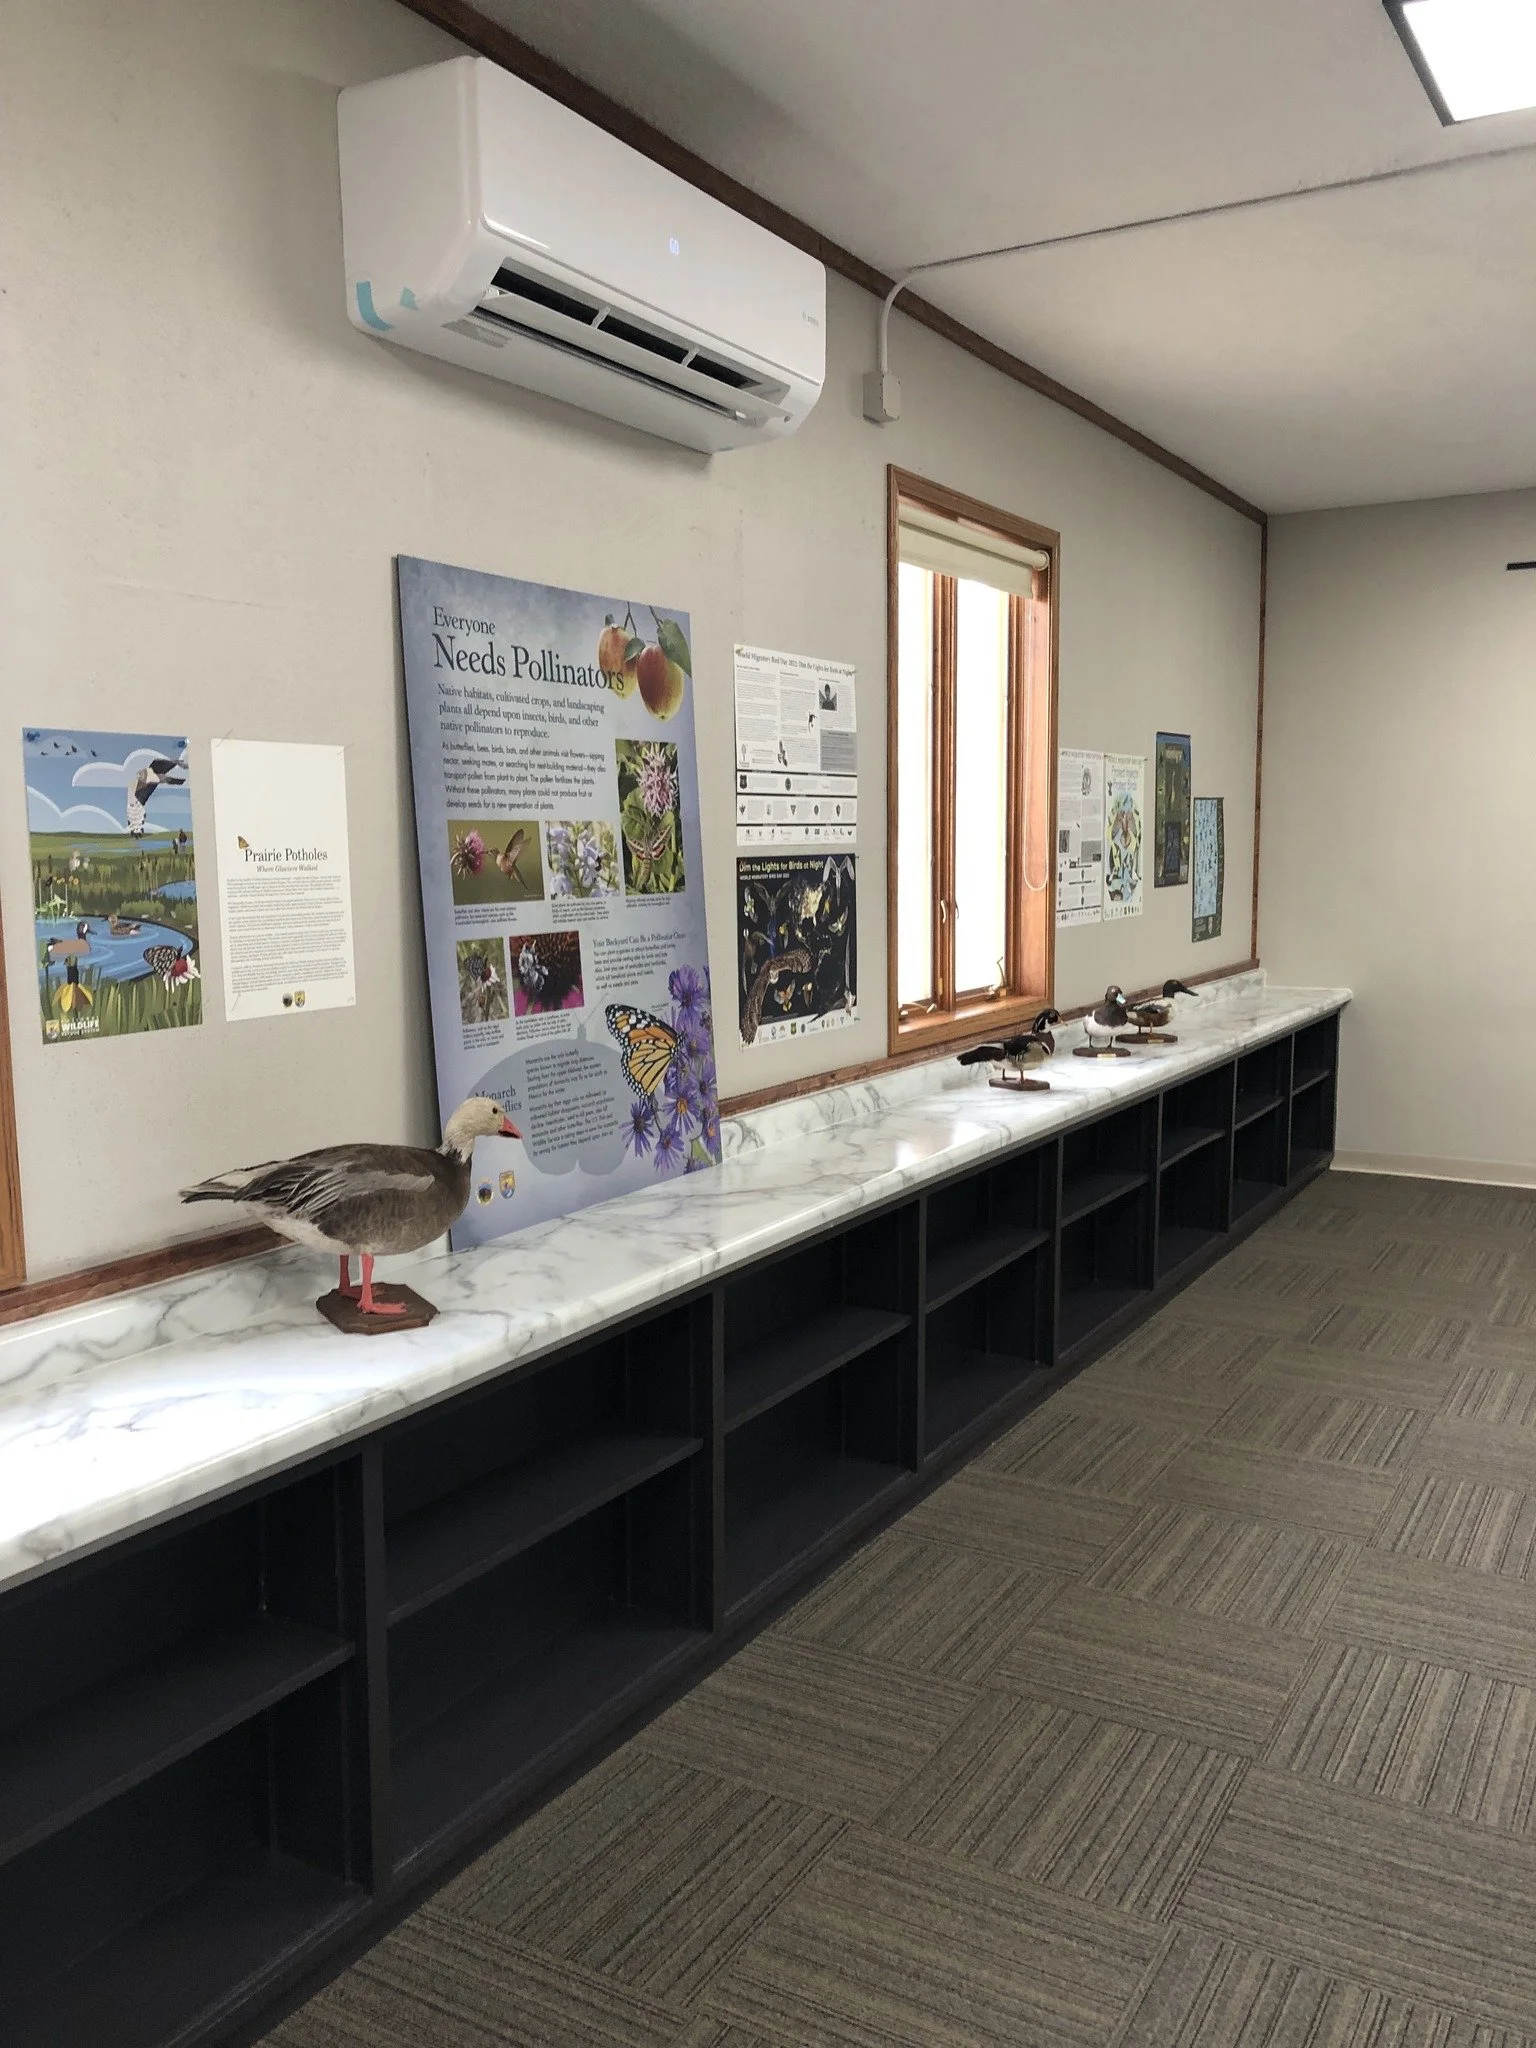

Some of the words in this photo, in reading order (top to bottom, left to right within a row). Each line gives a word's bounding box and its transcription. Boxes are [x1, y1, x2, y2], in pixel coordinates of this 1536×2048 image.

[433, 606, 495, 636] Everyone
[432, 632, 505, 677] Needs
[511, 644, 624, 691] Pollinators
[438, 683, 462, 697] Native
[464, 686, 494, 702] habitats,
[496, 691, 530, 704] cultivated
[553, 698, 565, 708] and
[567, 698, 604, 714] landscaping
[439, 701, 462, 715] plants
[464, 704, 472, 715] all
[474, 704, 501, 719] depend
[502, 711, 520, 721] upon
[569, 715, 580, 725] and
[582, 716, 599, 726] other
[441, 720, 462, 731] native
[464, 721, 503, 735] pollinators
[504, 727, 512, 735] to
[514, 727, 550, 739] reproduce.
[245, 848, 282, 862] Prairie
[285, 848, 328, 861] Potholes
[256, 865, 274, 873] Where
[739, 862, 751, 872] Dim
[761, 861, 780, 873] Lights
[789, 861, 803, 870] Birds
[809, 860, 823, 871] Night
[61, 1019, 99, 1031] WILDLIFE
